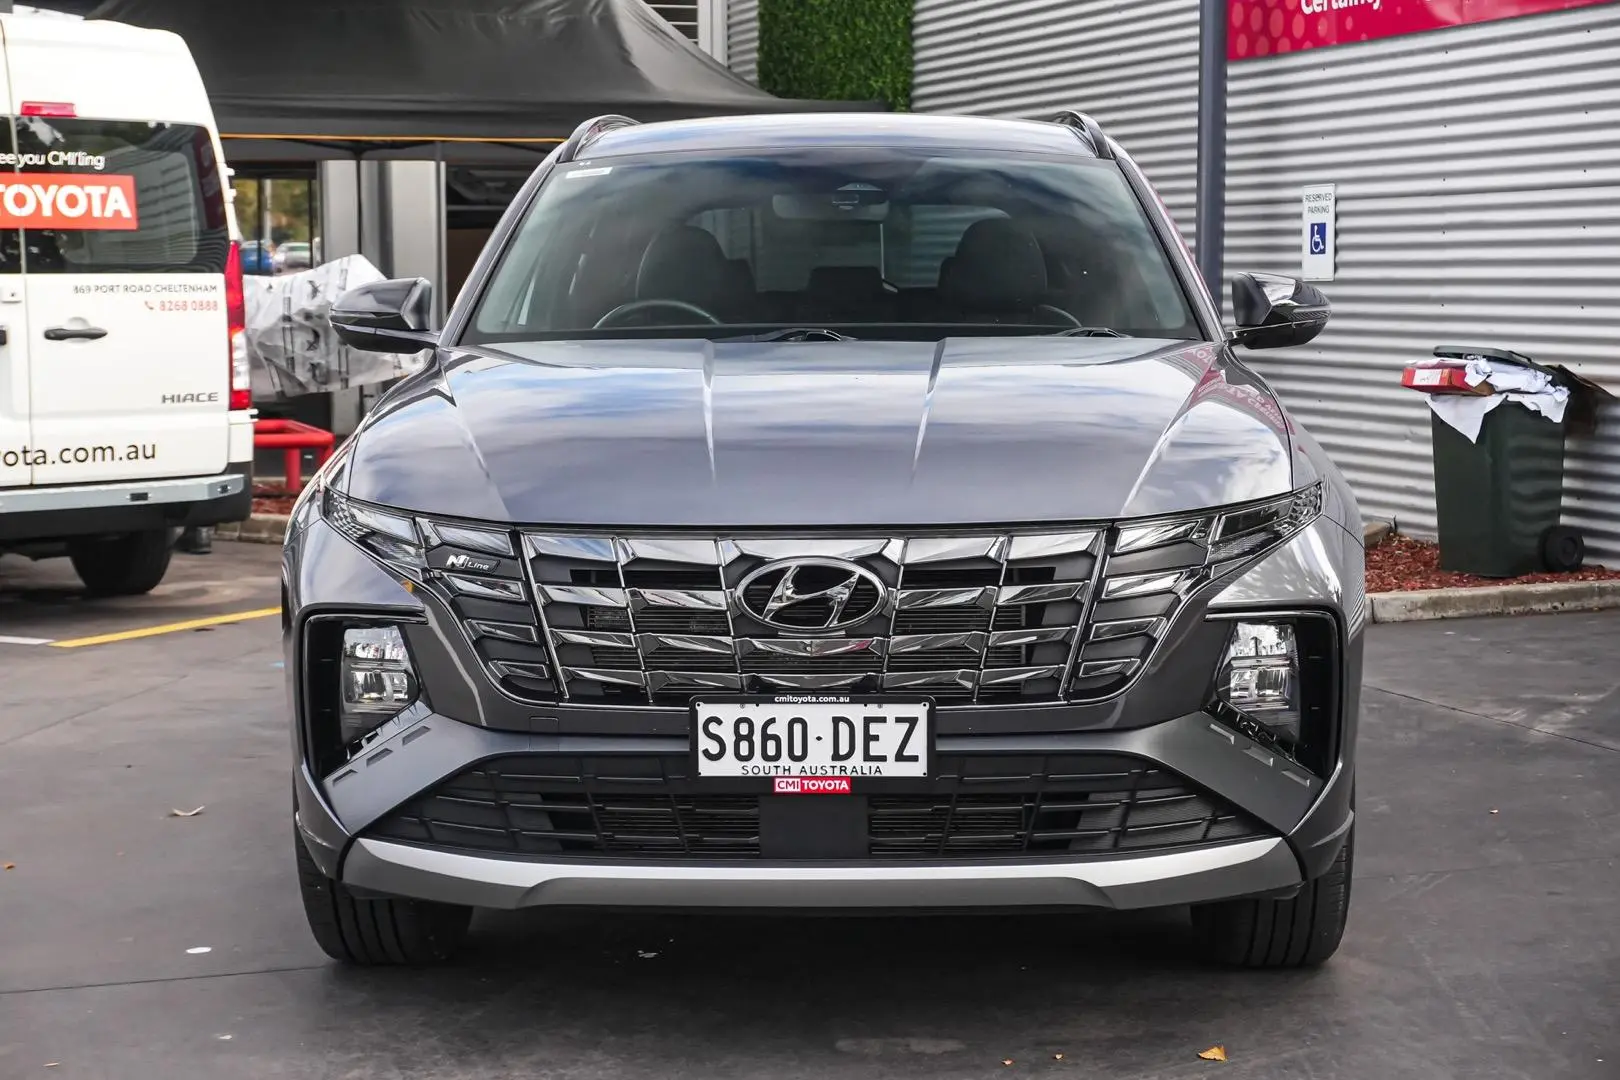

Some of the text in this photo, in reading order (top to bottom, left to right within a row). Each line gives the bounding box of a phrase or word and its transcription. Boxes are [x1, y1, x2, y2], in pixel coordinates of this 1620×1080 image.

[16, 153, 46, 168] you
[1305, 193, 1332, 202] RESERVED
[1307, 205, 1330, 214] PARKING
[73, 284, 218, 294] 869 PORT ROAD CHELTENHAM
[159, 300, 188, 311] 8268
[162, 392, 218, 403] HIACE
[774, 695, 850, 703] cmitoyota.com.au
[741, 765, 883, 776] SOUTH AUSTRALIA
[777, 780, 849, 791] CMI TOYOTA
